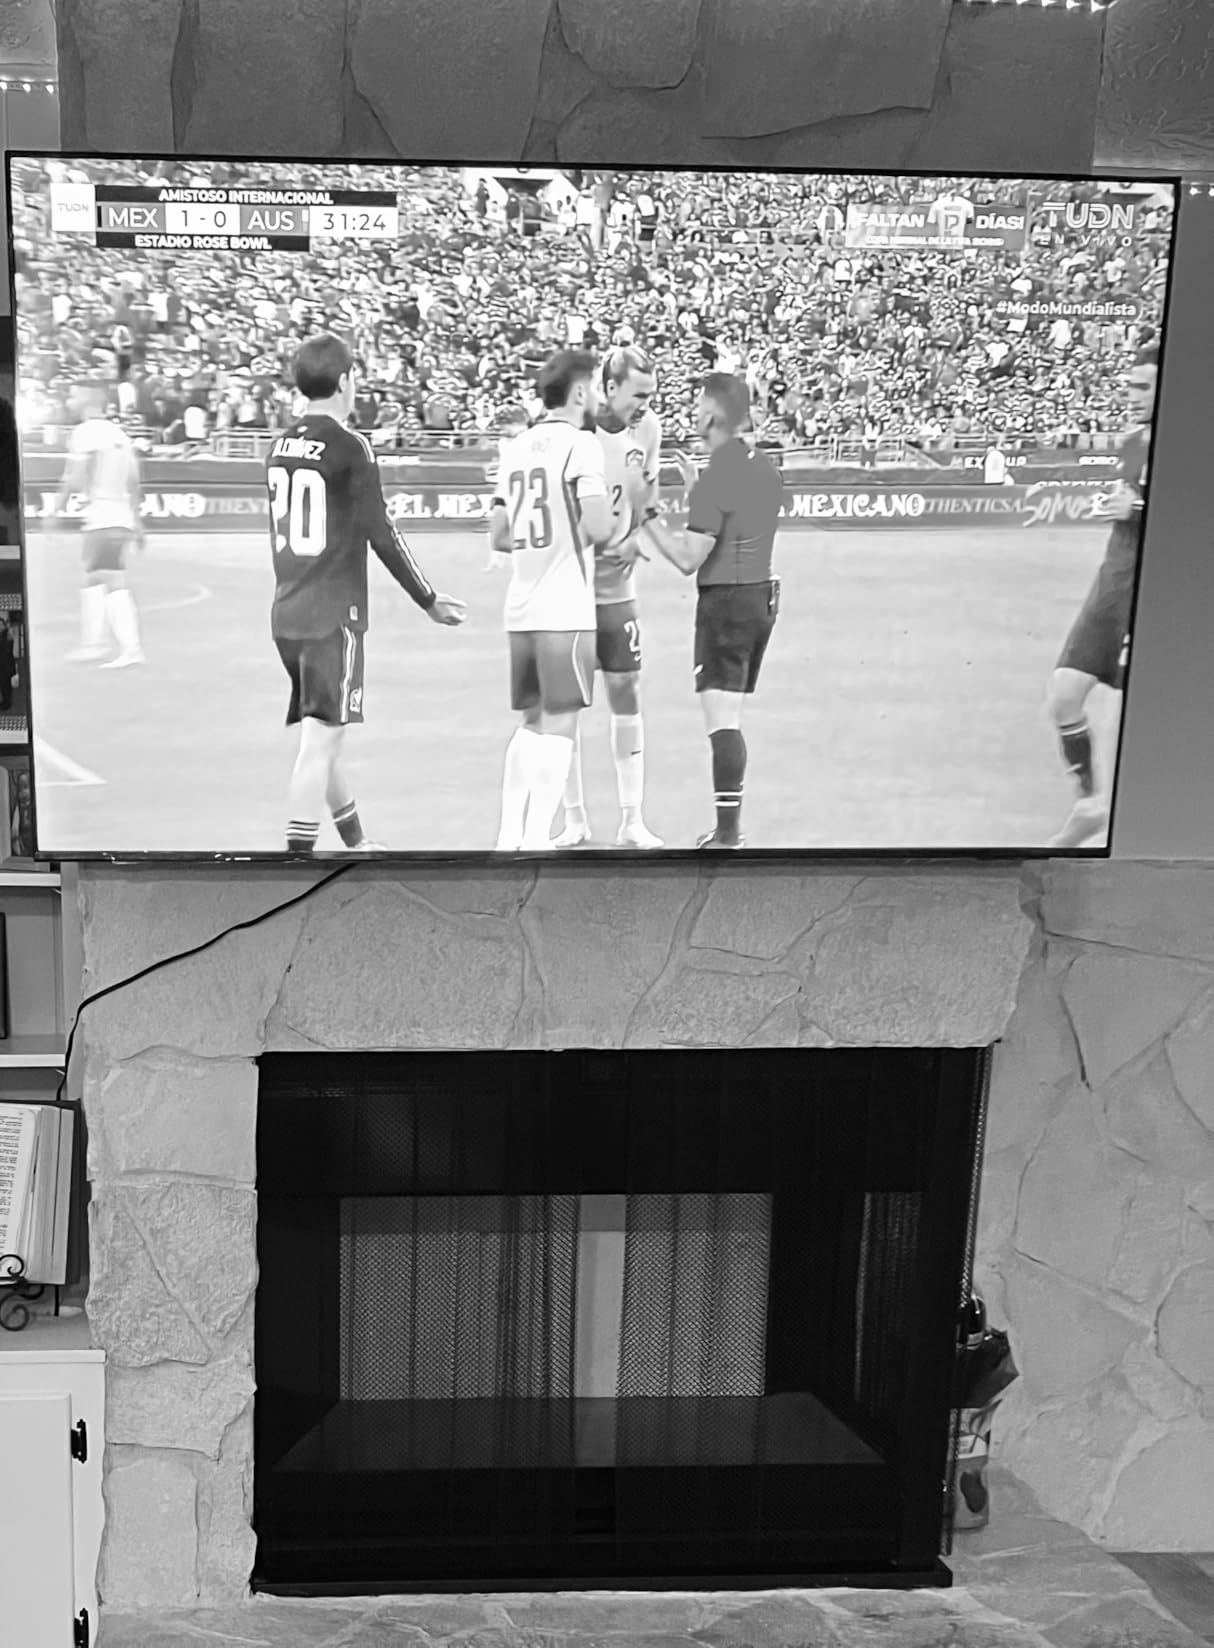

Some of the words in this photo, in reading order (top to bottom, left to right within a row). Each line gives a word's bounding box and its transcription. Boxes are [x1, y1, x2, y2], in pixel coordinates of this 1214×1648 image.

[158, 188, 227, 203] AMISTOSO
[228, 190, 334, 205] INTERNACIONAL
[108, 207, 158, 228] MEX
[247, 209, 295, 231] AUS
[323, 212, 386, 231] 31:24
[1042, 202, 1135, 230] TUDN
[134, 234, 192, 248] ESTADIO
[192, 236, 229, 249] ROSE
[229, 236, 272, 250] BOWL
[996, 300, 1137, 316] #ModoMundialista
[267, 466, 327, 556] 20
[510, 467, 553, 550] 23
[789, 493, 926, 518] MEXICANO
